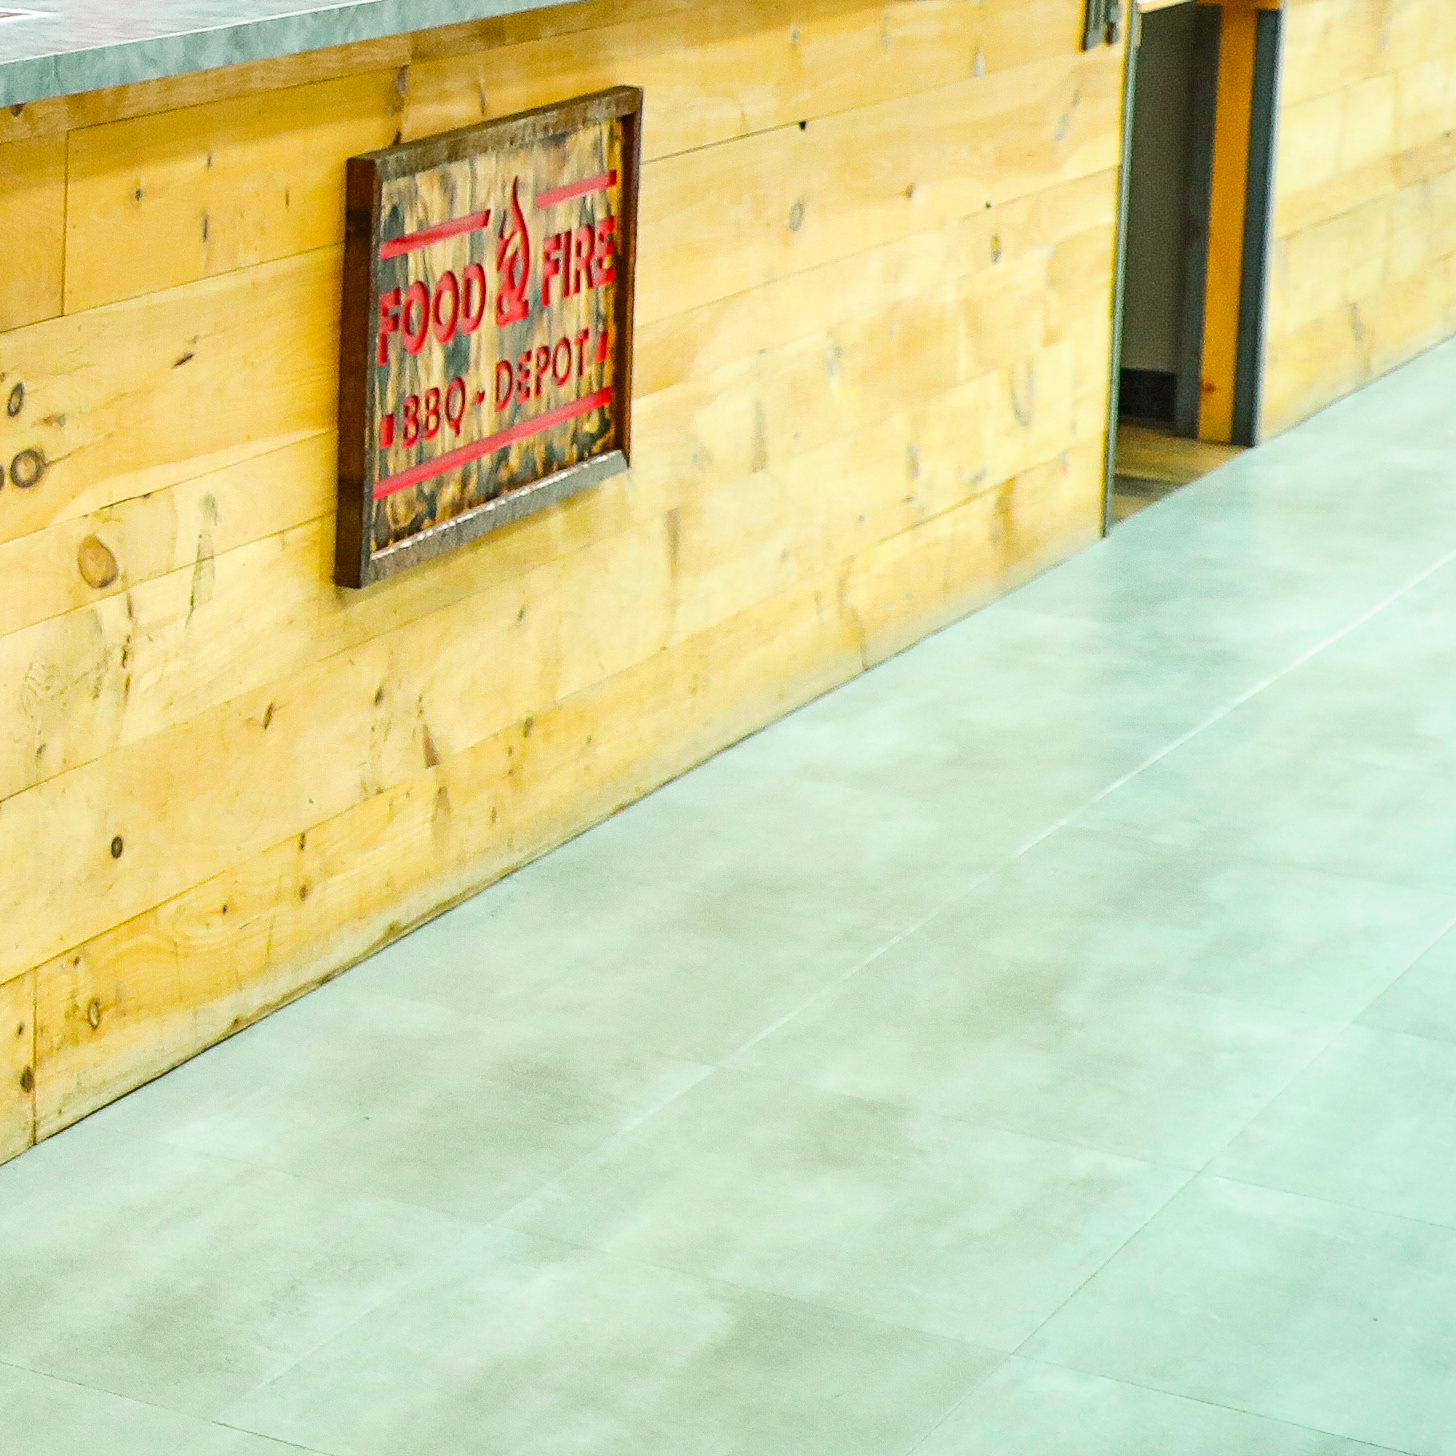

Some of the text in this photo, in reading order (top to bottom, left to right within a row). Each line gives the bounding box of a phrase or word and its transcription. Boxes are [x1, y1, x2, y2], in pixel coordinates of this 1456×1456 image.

[377, 262, 487, 367] FOOD
[541, 215, 617, 309] FIRE
[402, 376, 467, 450] BBQ
[494, 329, 589, 413] DEPOT
